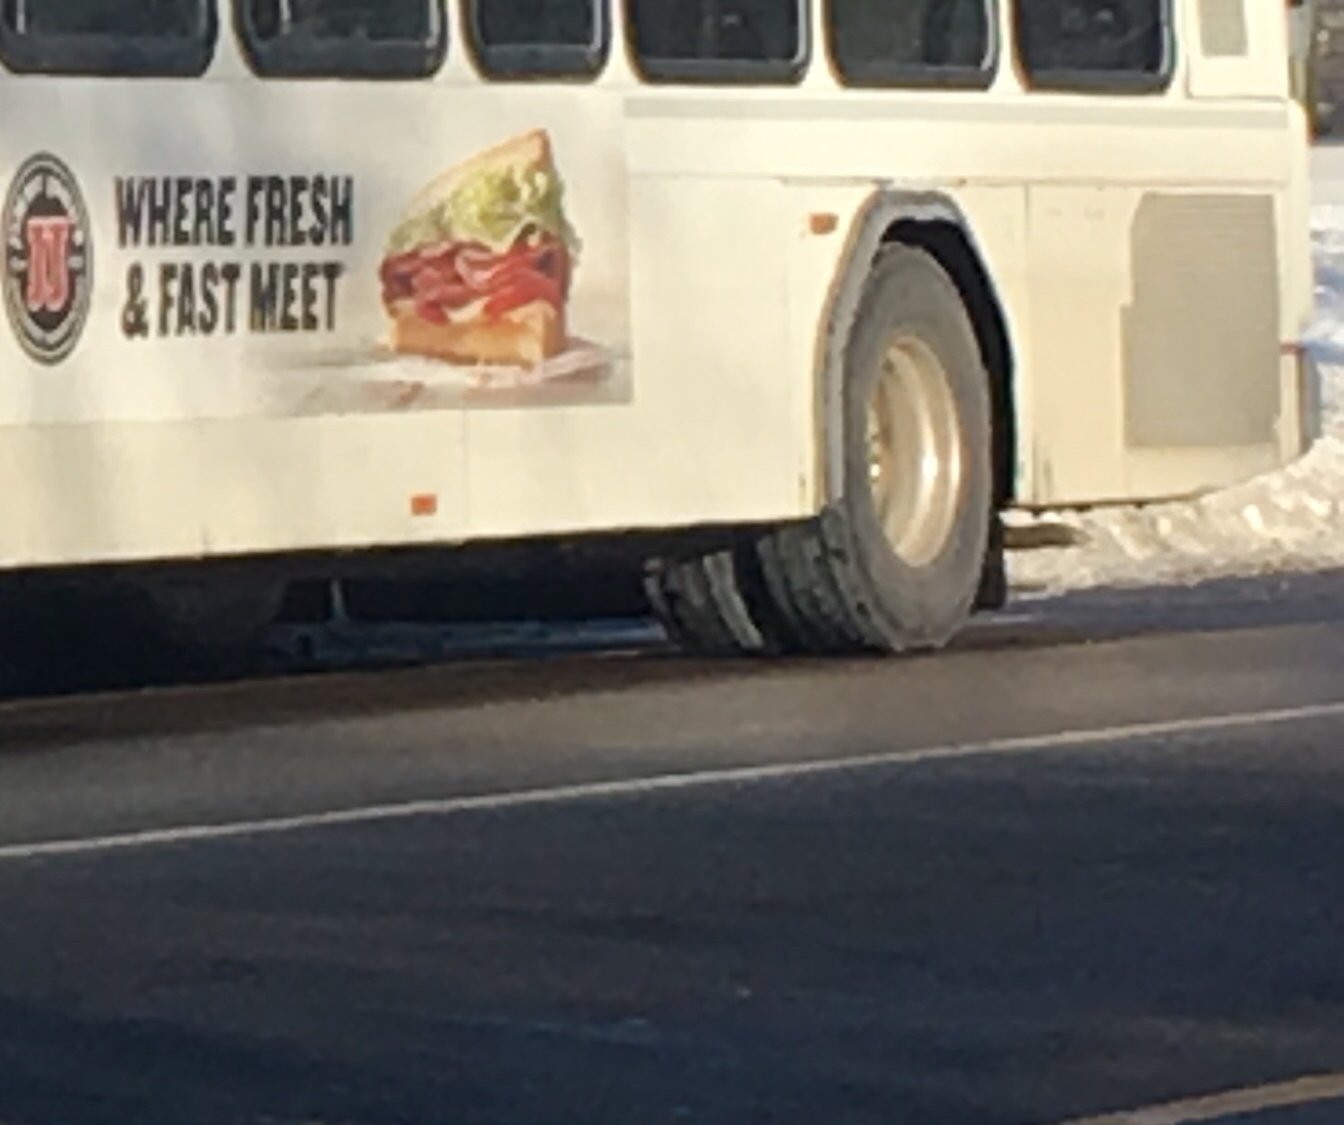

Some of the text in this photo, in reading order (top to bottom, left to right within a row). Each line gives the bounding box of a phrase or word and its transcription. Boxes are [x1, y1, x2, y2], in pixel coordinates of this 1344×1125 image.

[115, 176, 237, 249] WHERE
[243, 174, 354, 247] FRESH
[120, 262, 344, 338] & FAST MEET
